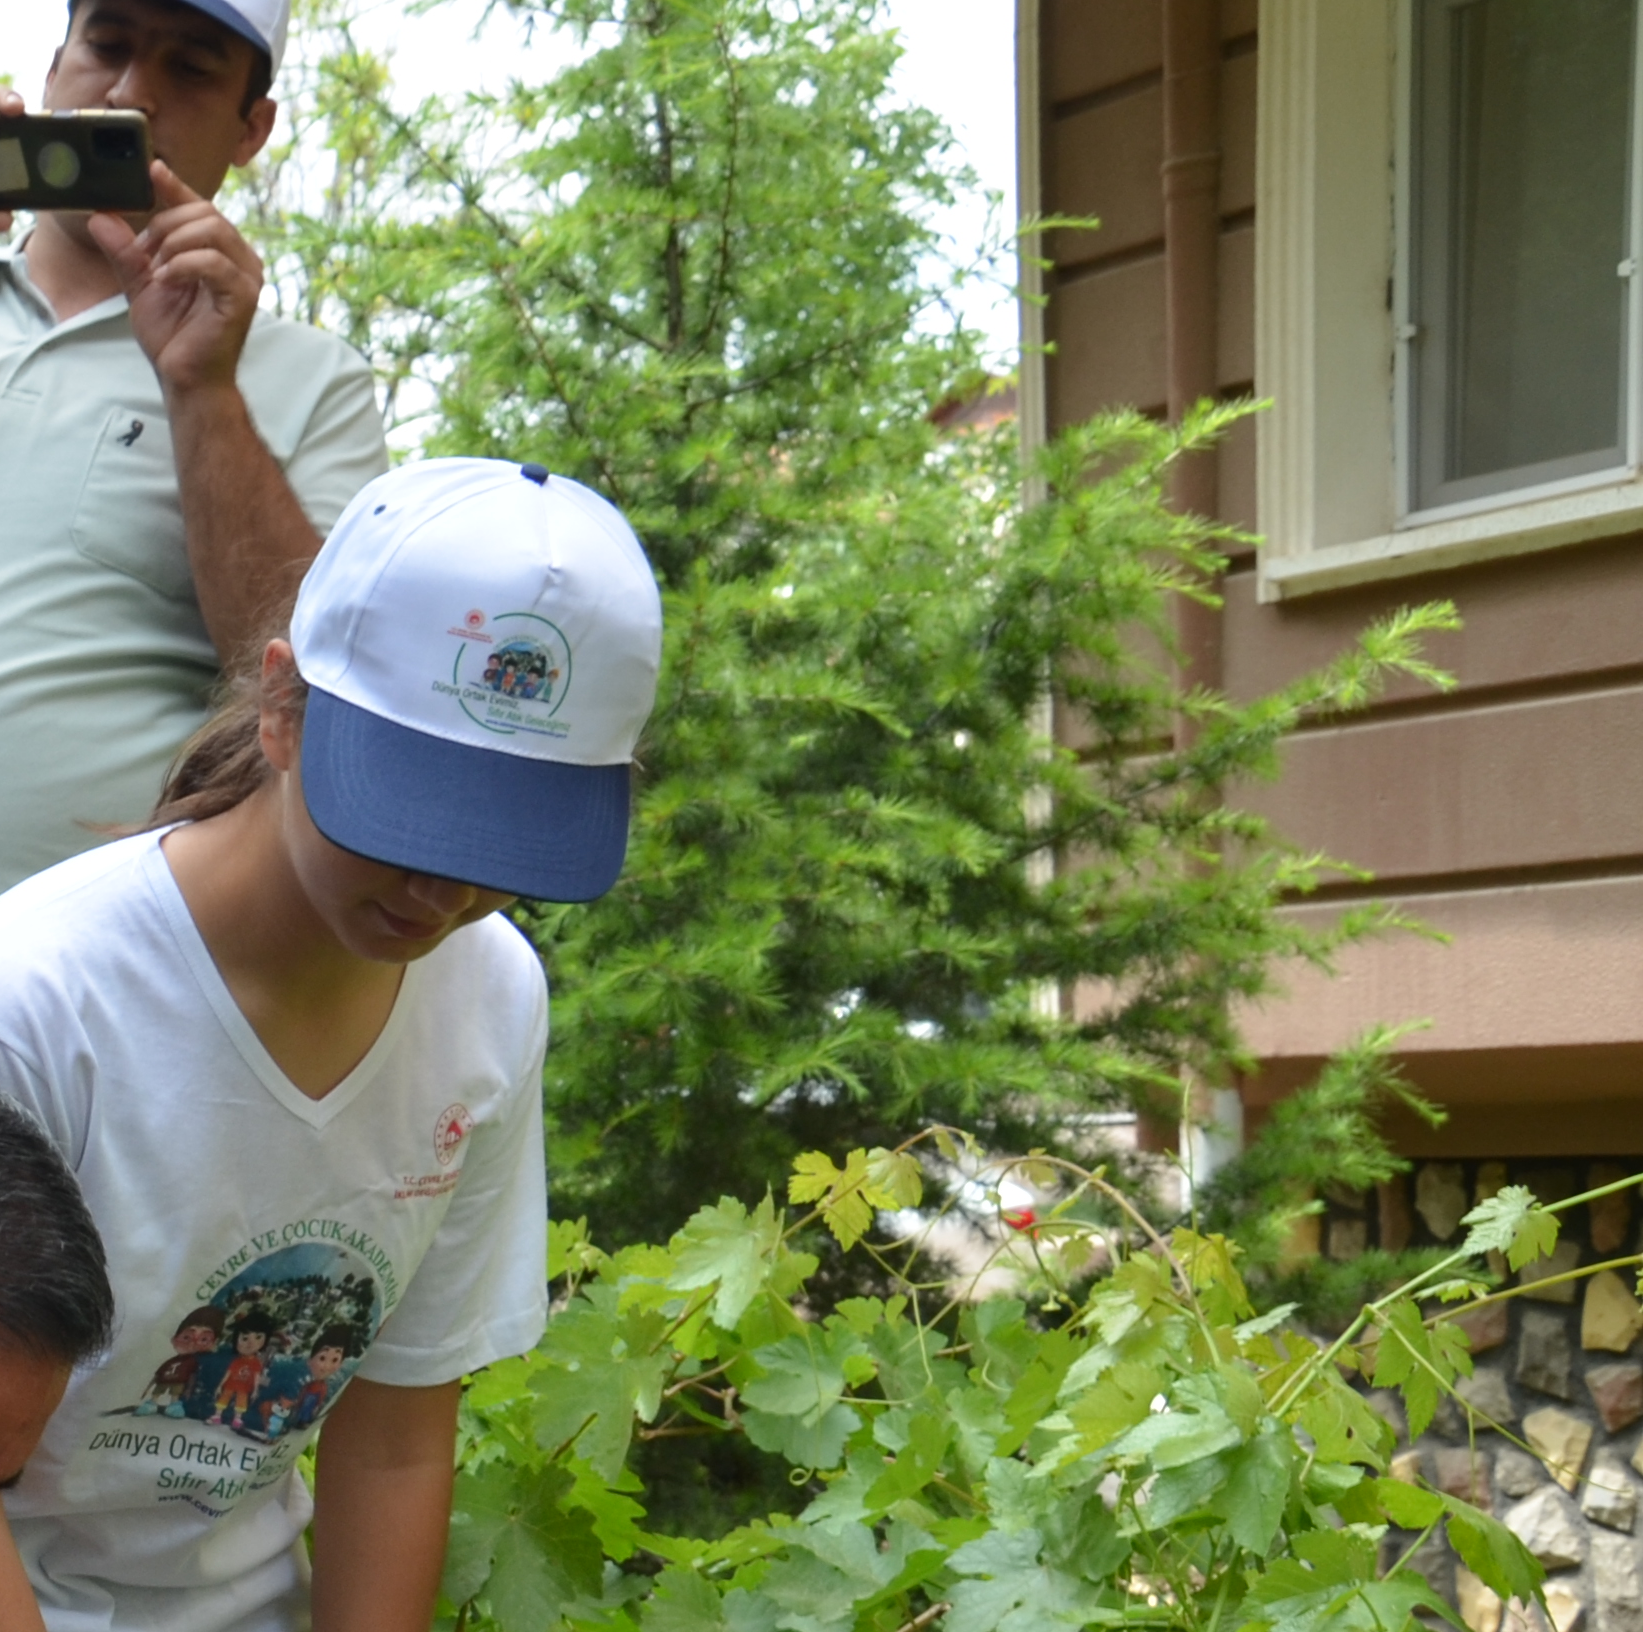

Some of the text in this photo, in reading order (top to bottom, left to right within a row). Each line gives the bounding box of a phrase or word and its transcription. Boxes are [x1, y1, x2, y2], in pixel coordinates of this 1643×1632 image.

[195, 1245, 253, 1302] ÇEVRE
[251, 1230, 279, 1252] VE
[89, 1429, 161, 1457] Dünya
[169, 1433, 234, 1469] Ortak
[157, 1466, 208, 1490] Sıfır
